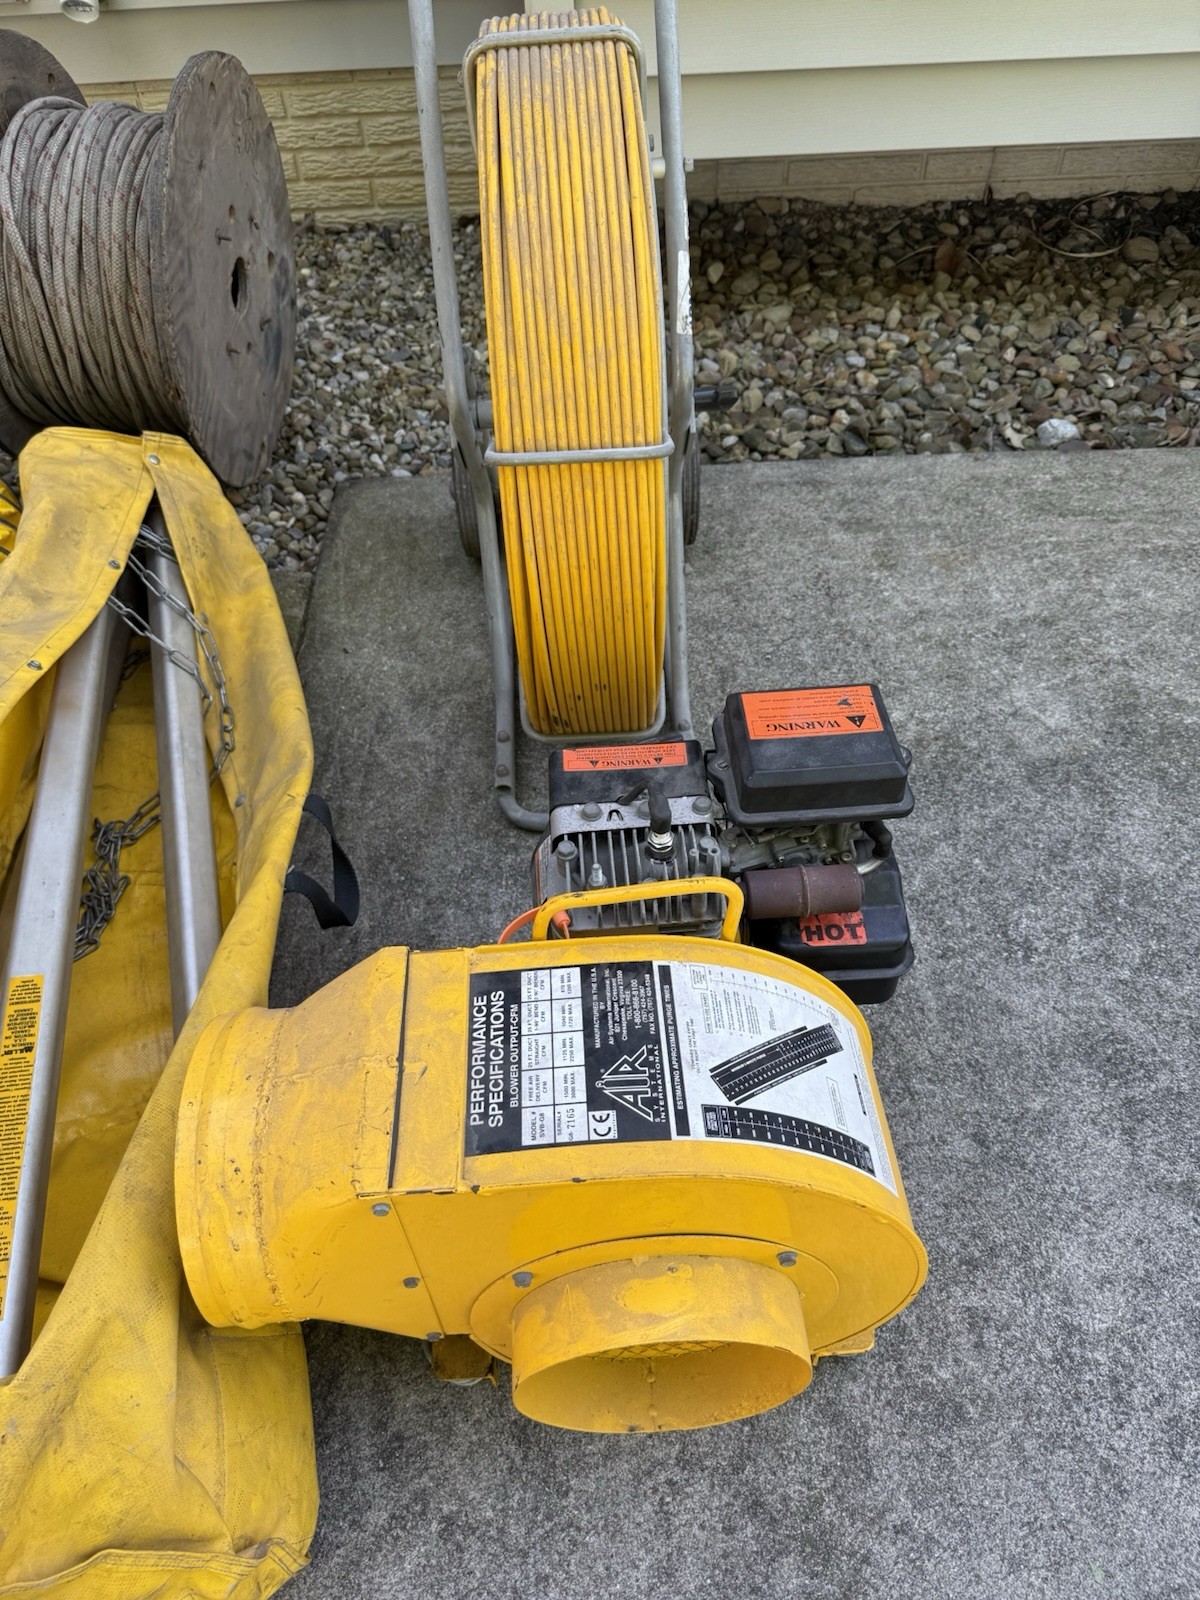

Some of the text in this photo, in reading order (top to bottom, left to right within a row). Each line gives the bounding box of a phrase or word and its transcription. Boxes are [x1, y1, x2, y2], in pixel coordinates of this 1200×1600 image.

[766, 720, 841, 732] WARNING
[804, 924, 862, 941] HOT
[593, 1002, 601, 1048] MANUFACTURED
[600, 1002, 605, 1010] BY
[631, 979, 642, 1029] 1-800-866-8100
[4, 1046, 34, 1055] MILLER
[470, 995, 487, 1126] PERFORMANCE
[488, 990, 504, 1127] SPECIFICATIONS
[510, 1004, 519, 1107] BLOWER OUTPUT-CFM
[663, 984, 684, 1110] ESTIMATING APPROXIMATE PURGE TIMES
[595, 1045, 654, 1123] AIR
[648, 1044, 660, 1123] SYSTEMS
[654, 1044, 666, 1123] INTERNATIONAL
[566, 1108, 575, 1129] 7165
